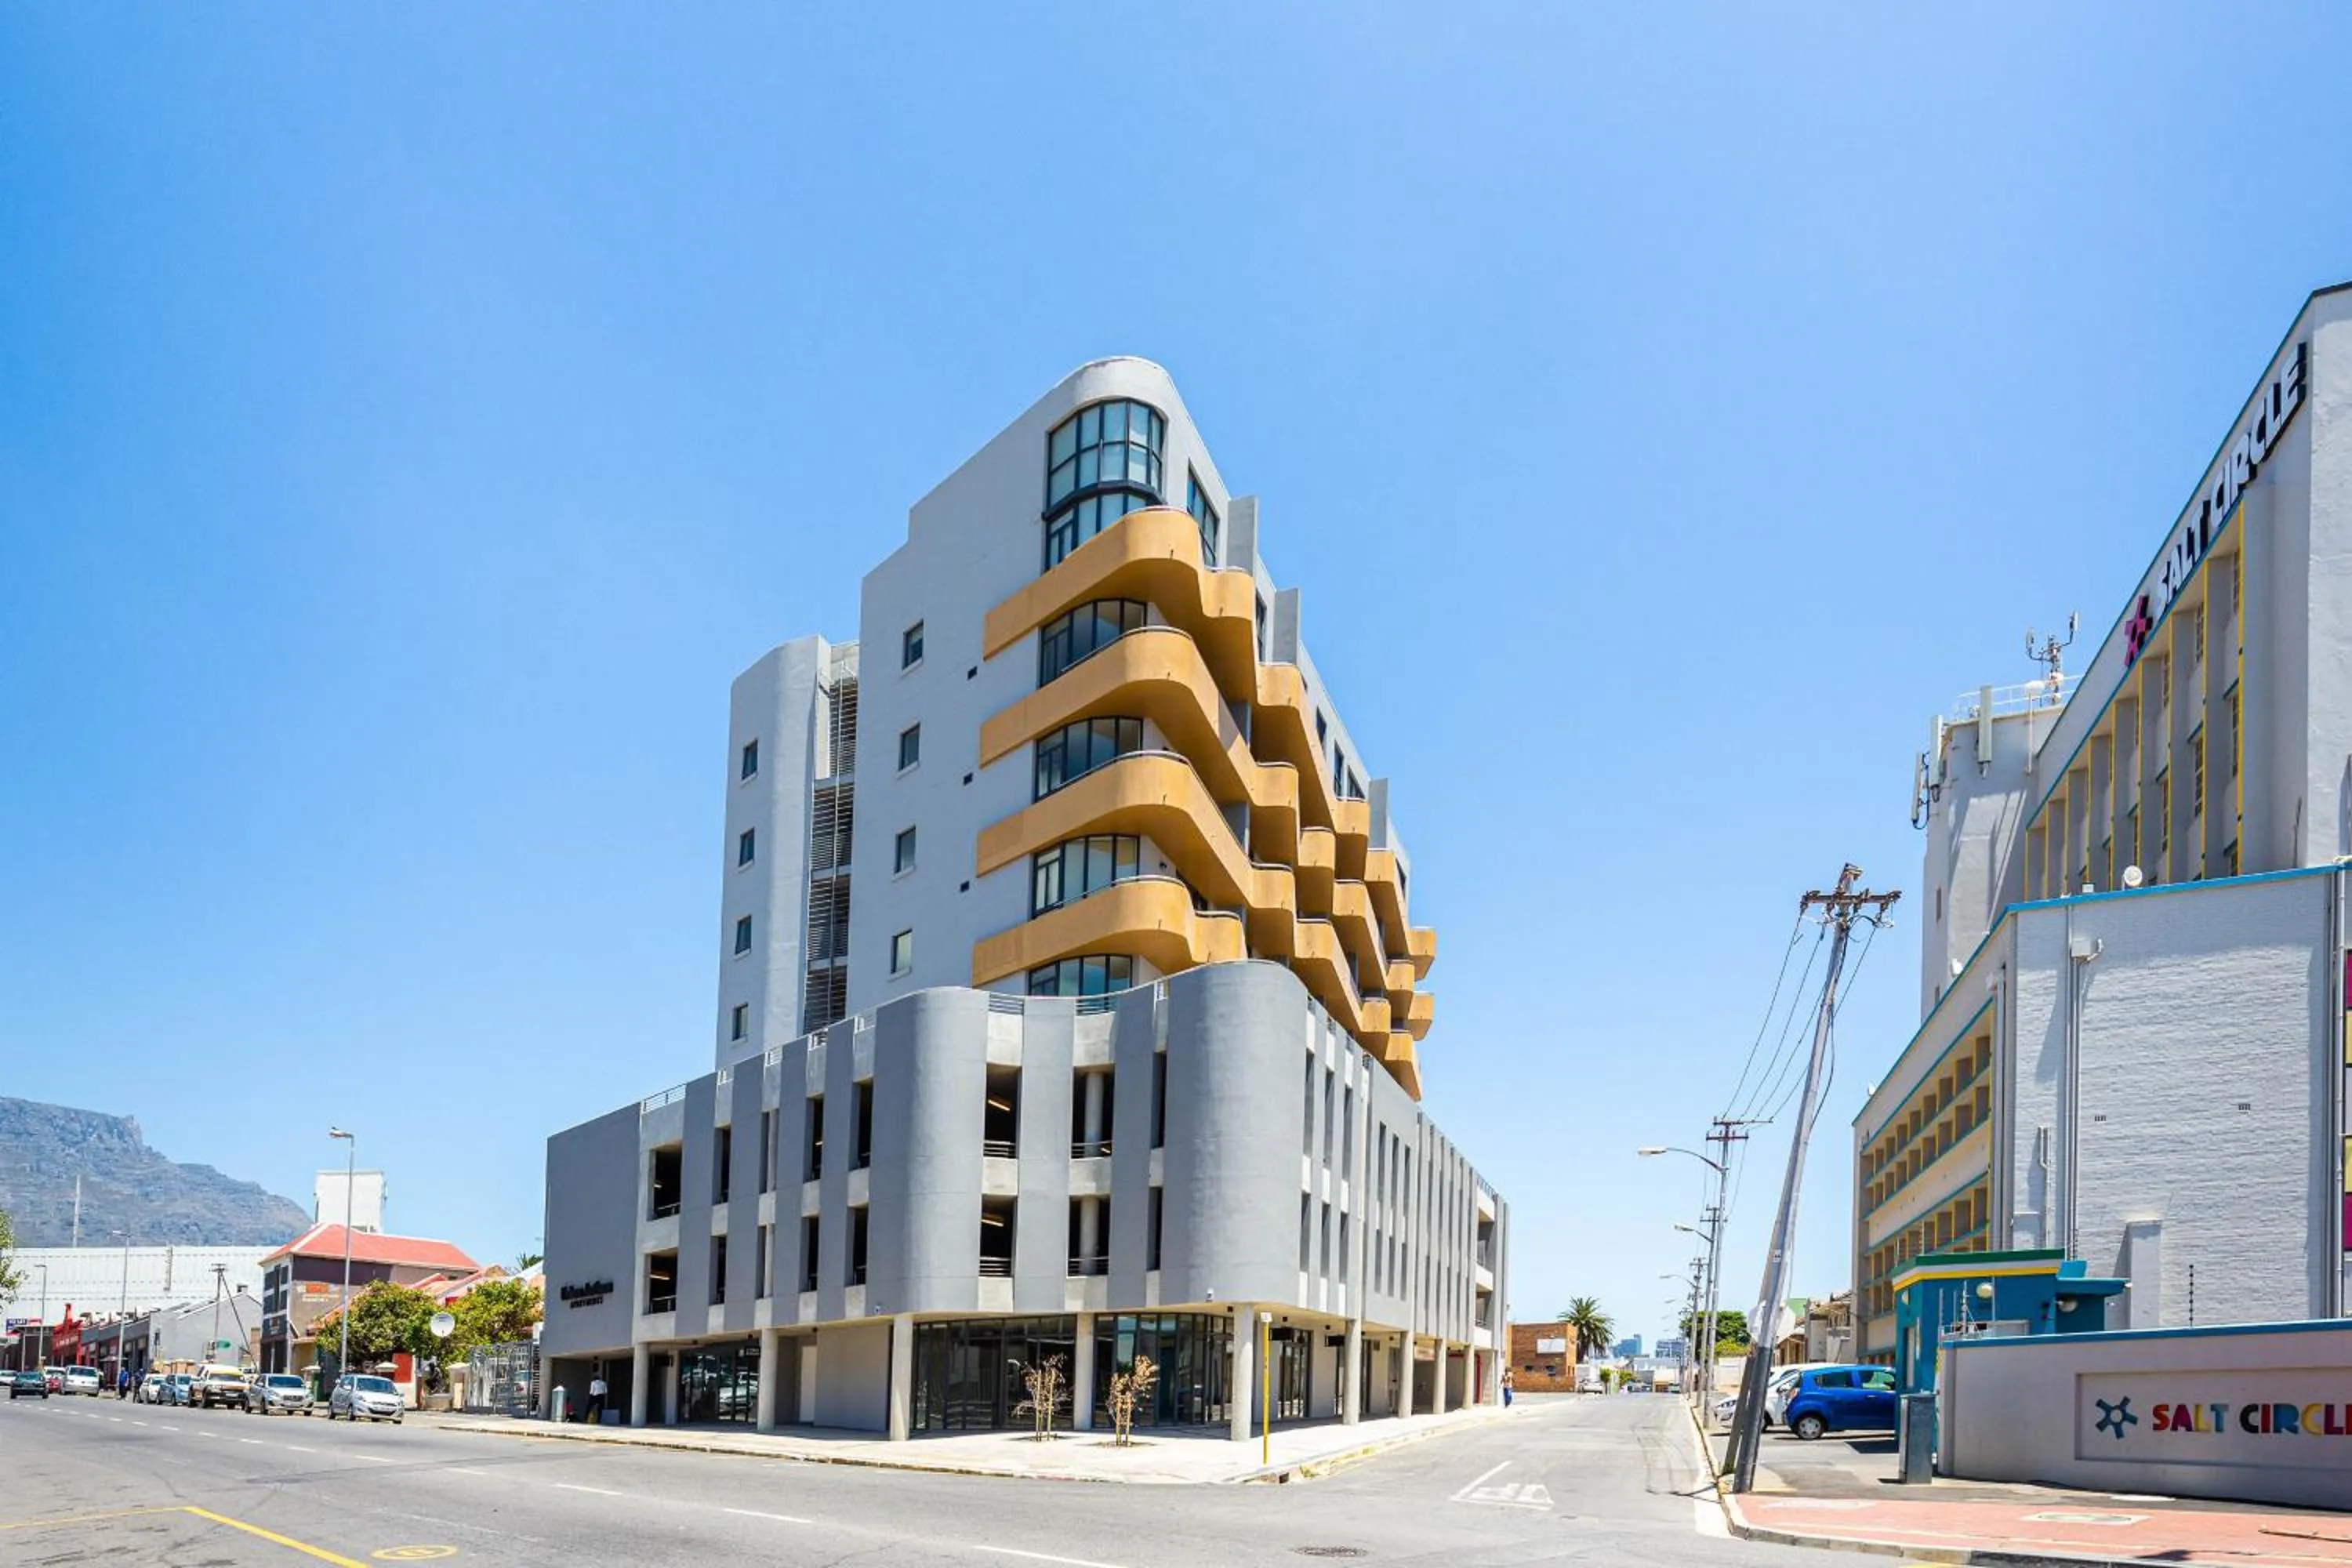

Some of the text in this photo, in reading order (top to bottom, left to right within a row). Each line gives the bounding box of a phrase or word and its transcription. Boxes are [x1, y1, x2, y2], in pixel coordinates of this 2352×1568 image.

[2156, 342, 2307, 616] SALT CIRCLE
[2152, 1403, 2229, 1433] SALT
